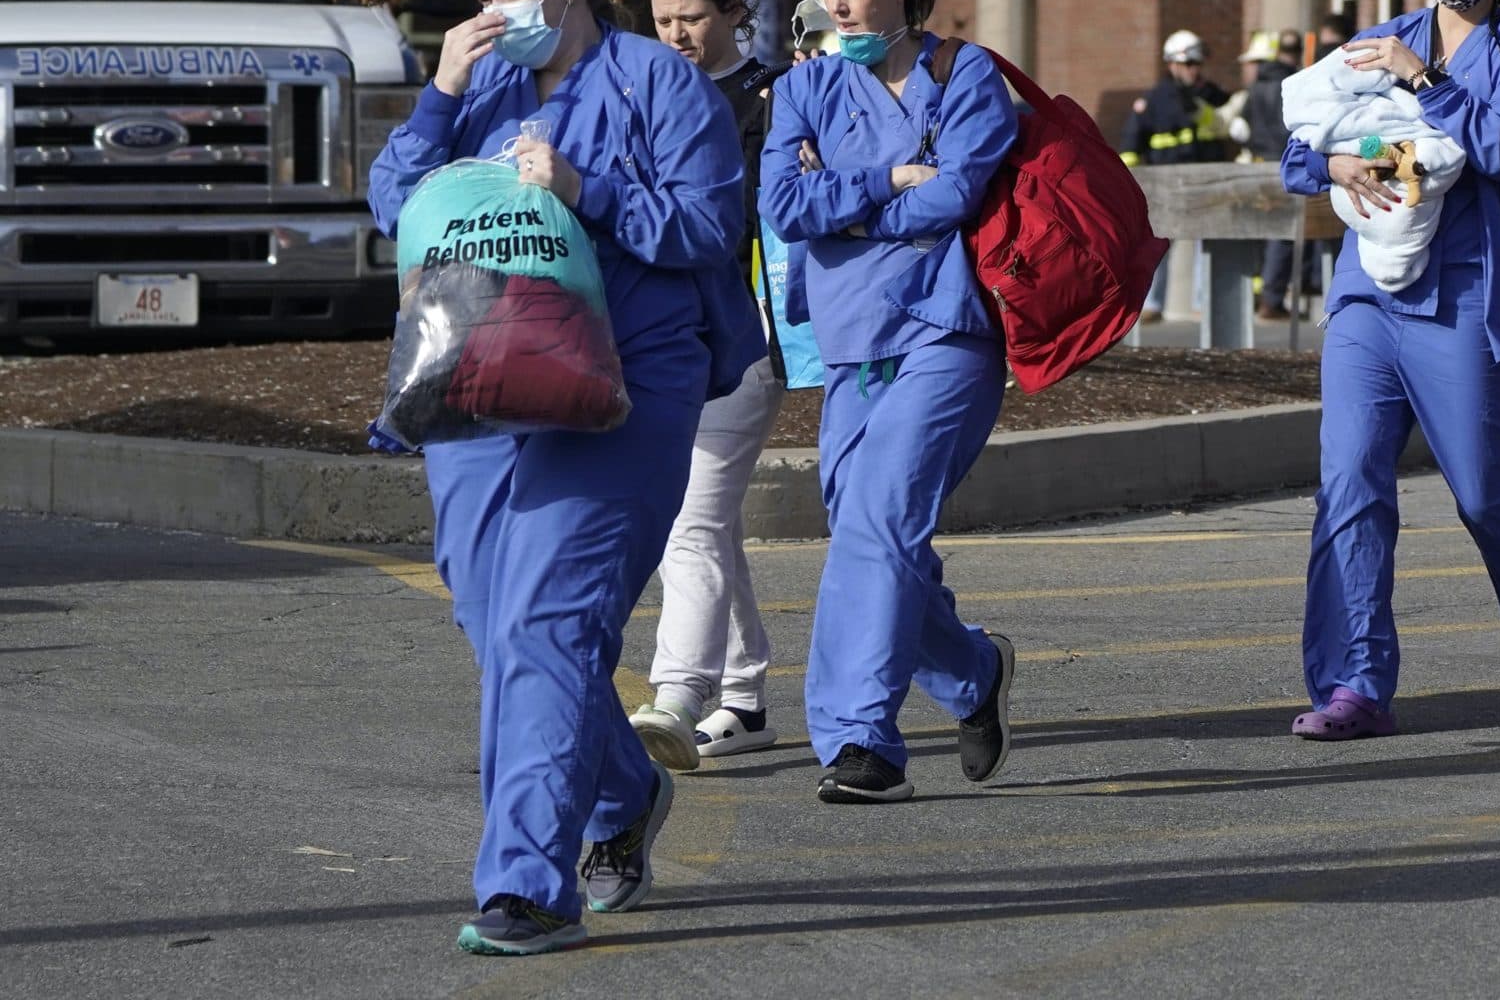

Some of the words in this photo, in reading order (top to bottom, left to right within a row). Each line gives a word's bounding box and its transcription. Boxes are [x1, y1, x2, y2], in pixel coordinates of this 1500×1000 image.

[442, 208, 544, 239] Patient
[422, 230, 569, 272] Belongings
[136, 287, 162, 313] 48
